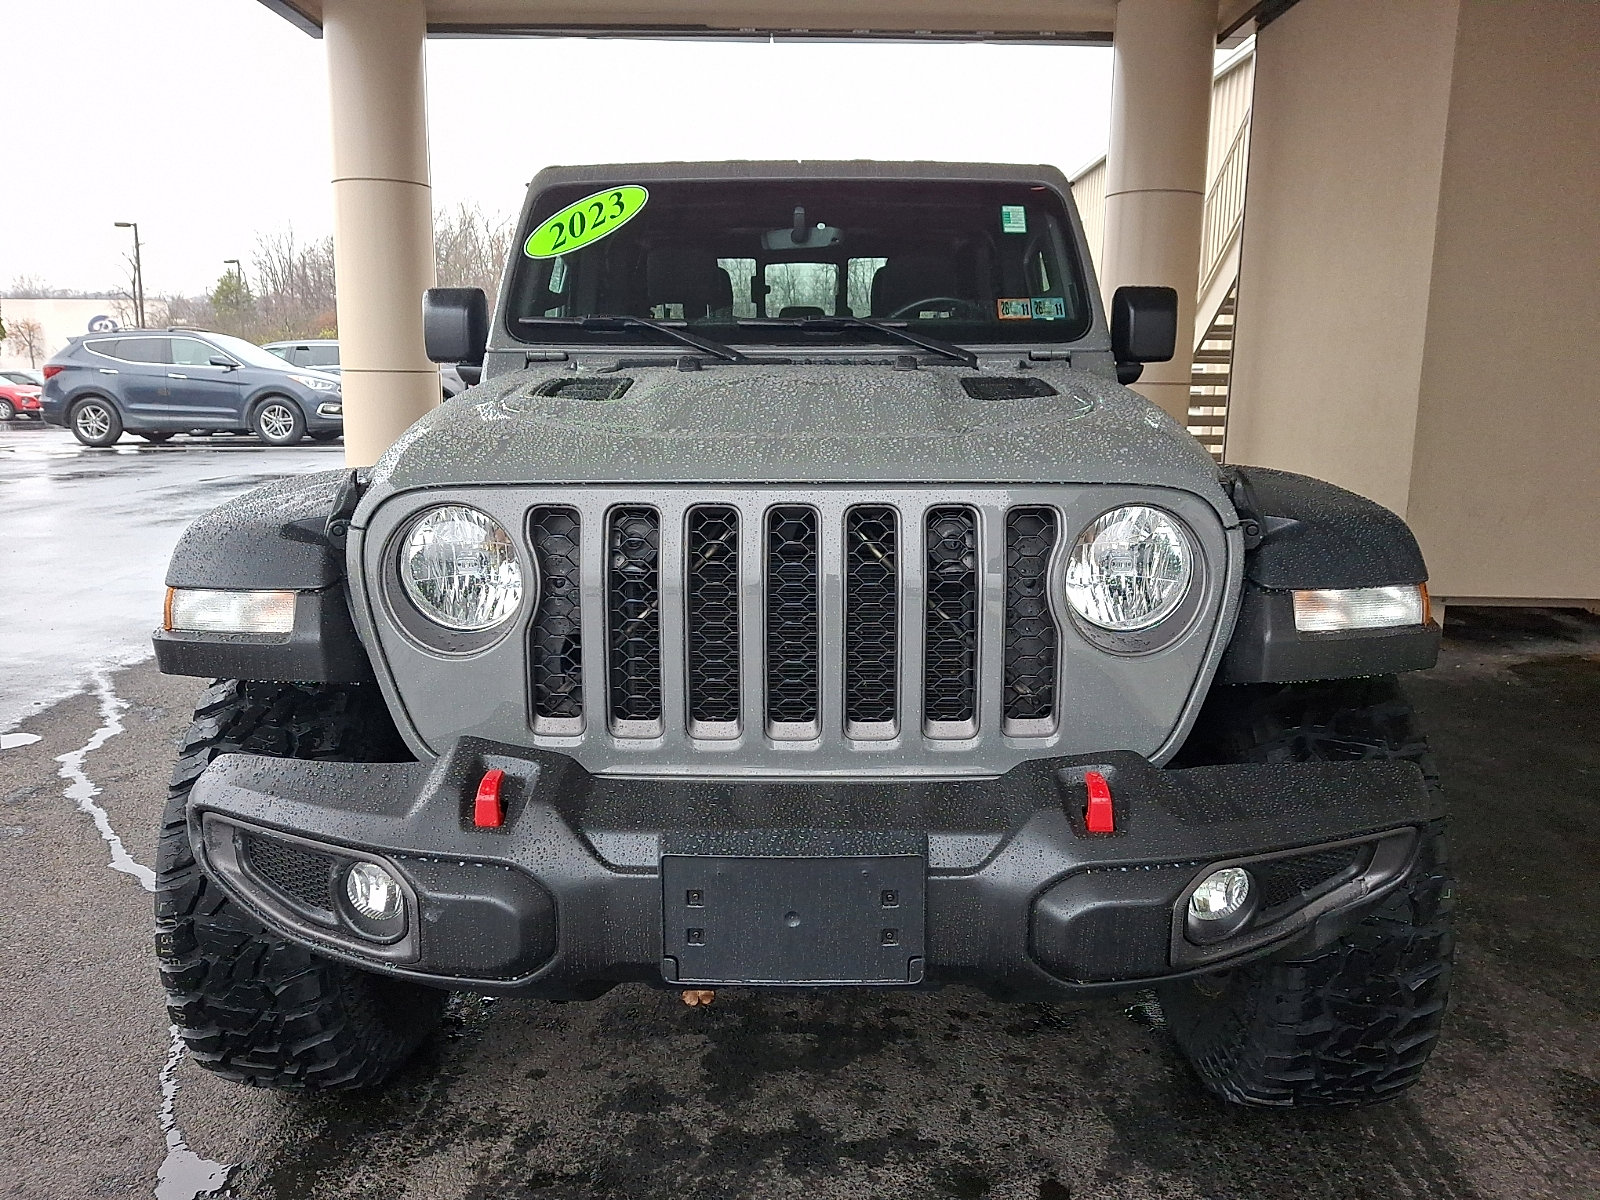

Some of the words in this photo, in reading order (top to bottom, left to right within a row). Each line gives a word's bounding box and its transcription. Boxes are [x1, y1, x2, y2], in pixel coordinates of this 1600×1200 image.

[549, 191, 625, 251] 2023
[1021, 303, 1029, 315] 11
[1054, 303, 1063, 315] 11
